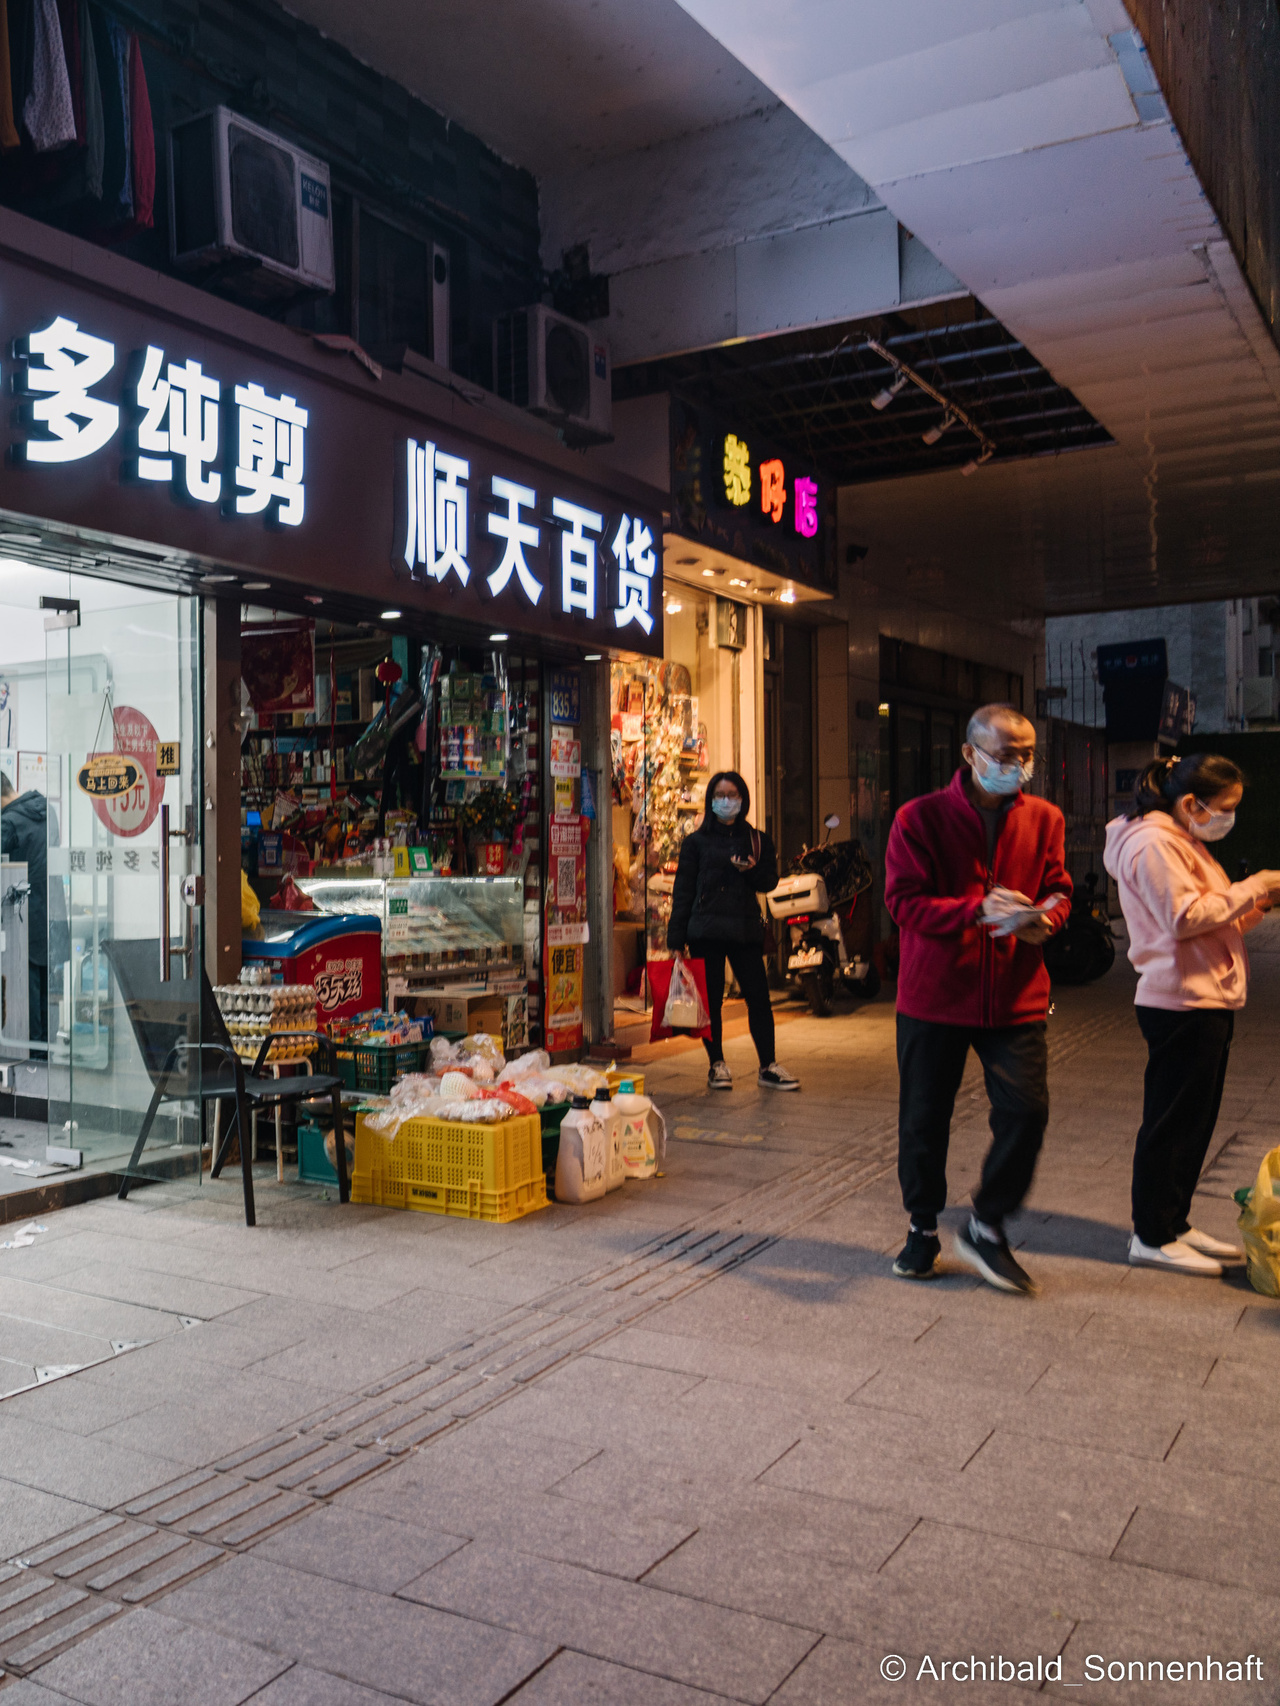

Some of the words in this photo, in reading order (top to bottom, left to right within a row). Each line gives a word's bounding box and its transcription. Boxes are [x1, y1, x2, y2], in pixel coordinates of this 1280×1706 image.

[302, 178, 326, 199] KELON
[404, 437, 657, 636] 顺天百货
[552, 691, 570, 718] 835
[160, 745, 175, 765] 推
[86, 775, 129, 791] 马上回来
[552, 948, 576, 975] 便宜
